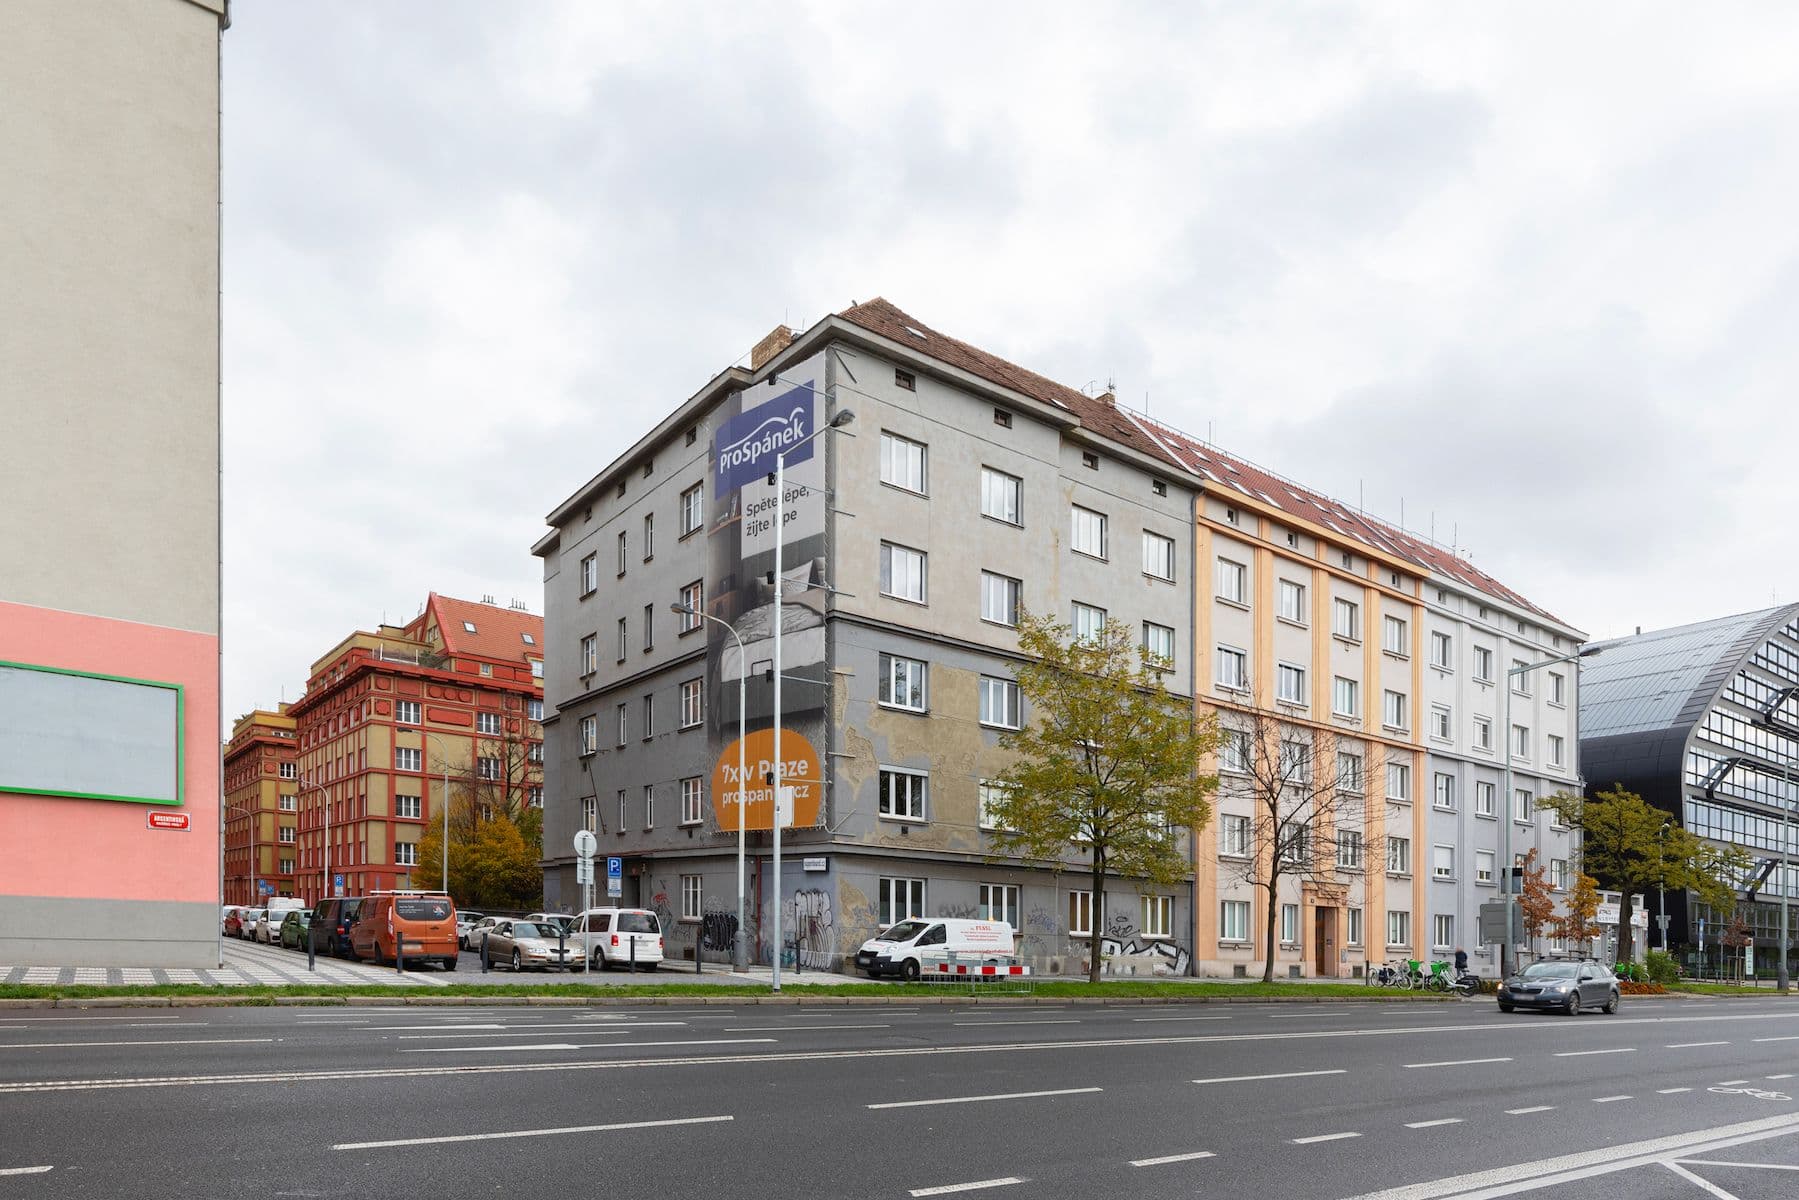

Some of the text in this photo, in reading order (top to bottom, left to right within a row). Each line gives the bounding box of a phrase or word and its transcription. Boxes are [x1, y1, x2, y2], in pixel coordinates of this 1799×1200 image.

[746, 497, 778, 517] Spěte
[746, 510, 797, 537] žijte lpe
[722, 785, 810, 809] prospancz
